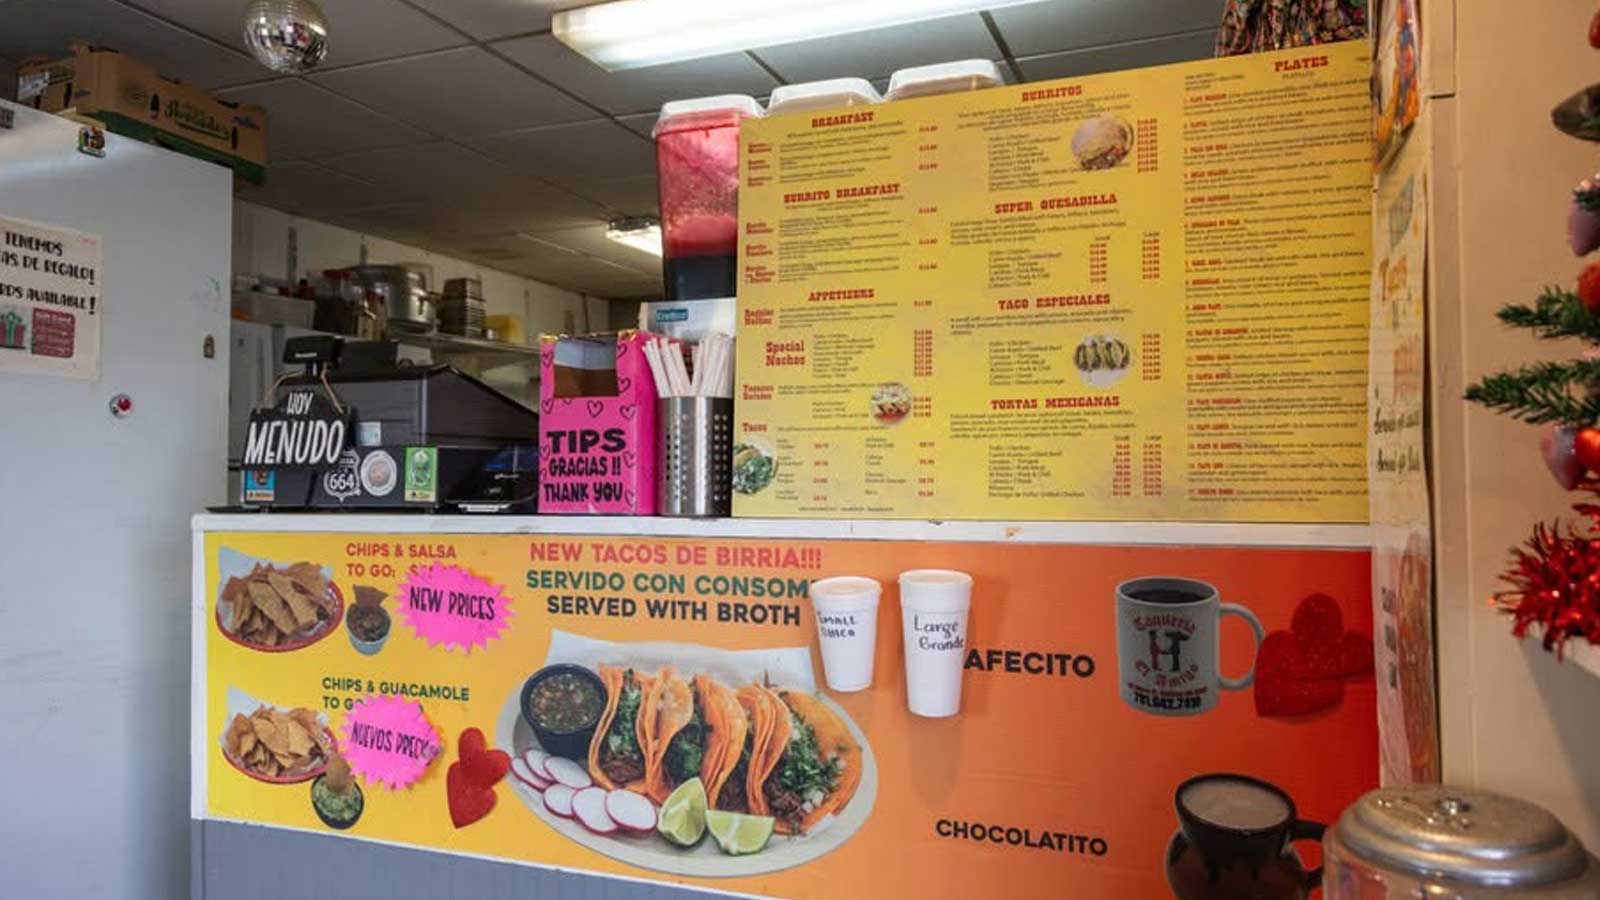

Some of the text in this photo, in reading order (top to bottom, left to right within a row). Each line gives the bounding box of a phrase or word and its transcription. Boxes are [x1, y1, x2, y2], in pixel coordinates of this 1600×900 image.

[1274, 55, 1328, 72] PLATES
[1021, 85, 1082, 102] BURRITOS
[811, 112, 874, 128] BREAKFAST
[784, 184, 901, 203] BURRITO BREAKFAST
[994, 194, 1117, 214] SUPER QUESADILLA
[5, 231, 63, 257] TENEMOS
[23, 256, 39, 271] DE
[808, 289, 875, 301] APPETIZERS
[998, 294, 1110, 310] TACO ESPECIALES
[766, 340, 805, 354] Special
[766, 355, 806, 367] Nachos
[286, 392, 314, 415] HOY
[991, 395, 1120, 410] TORTAS MEXICANAS
[244, 420, 345, 465] MENUDO
[546, 428, 627, 453] TIPS
[549, 456, 608, 477] GRACIAS
[330, 473, 355, 490] 664
[544, 482, 623, 502] THANK YOU
[346, 543, 456, 558] CHIPS & SALSA
[530, 543, 822, 569] NEW TACOS DE BIRRIA!!!
[346, 563, 366, 577] TO
[370, 564, 396, 578] GO:
[526, 569, 817, 599] SERVIDO CON CONSOM
[409, 587, 496, 621] NEW PRICES
[546, 595, 801, 627] SERVED WITH BROTH
[914, 614, 959, 639] Large
[963, 649, 1096, 678] AFECITO
[322, 677, 470, 701] CHIPS & GUACAMOLE
[323, 696, 342, 709] TO
[352, 721, 393, 752] NUEVOS
[936, 819, 1108, 857] CHOCOLATITO
